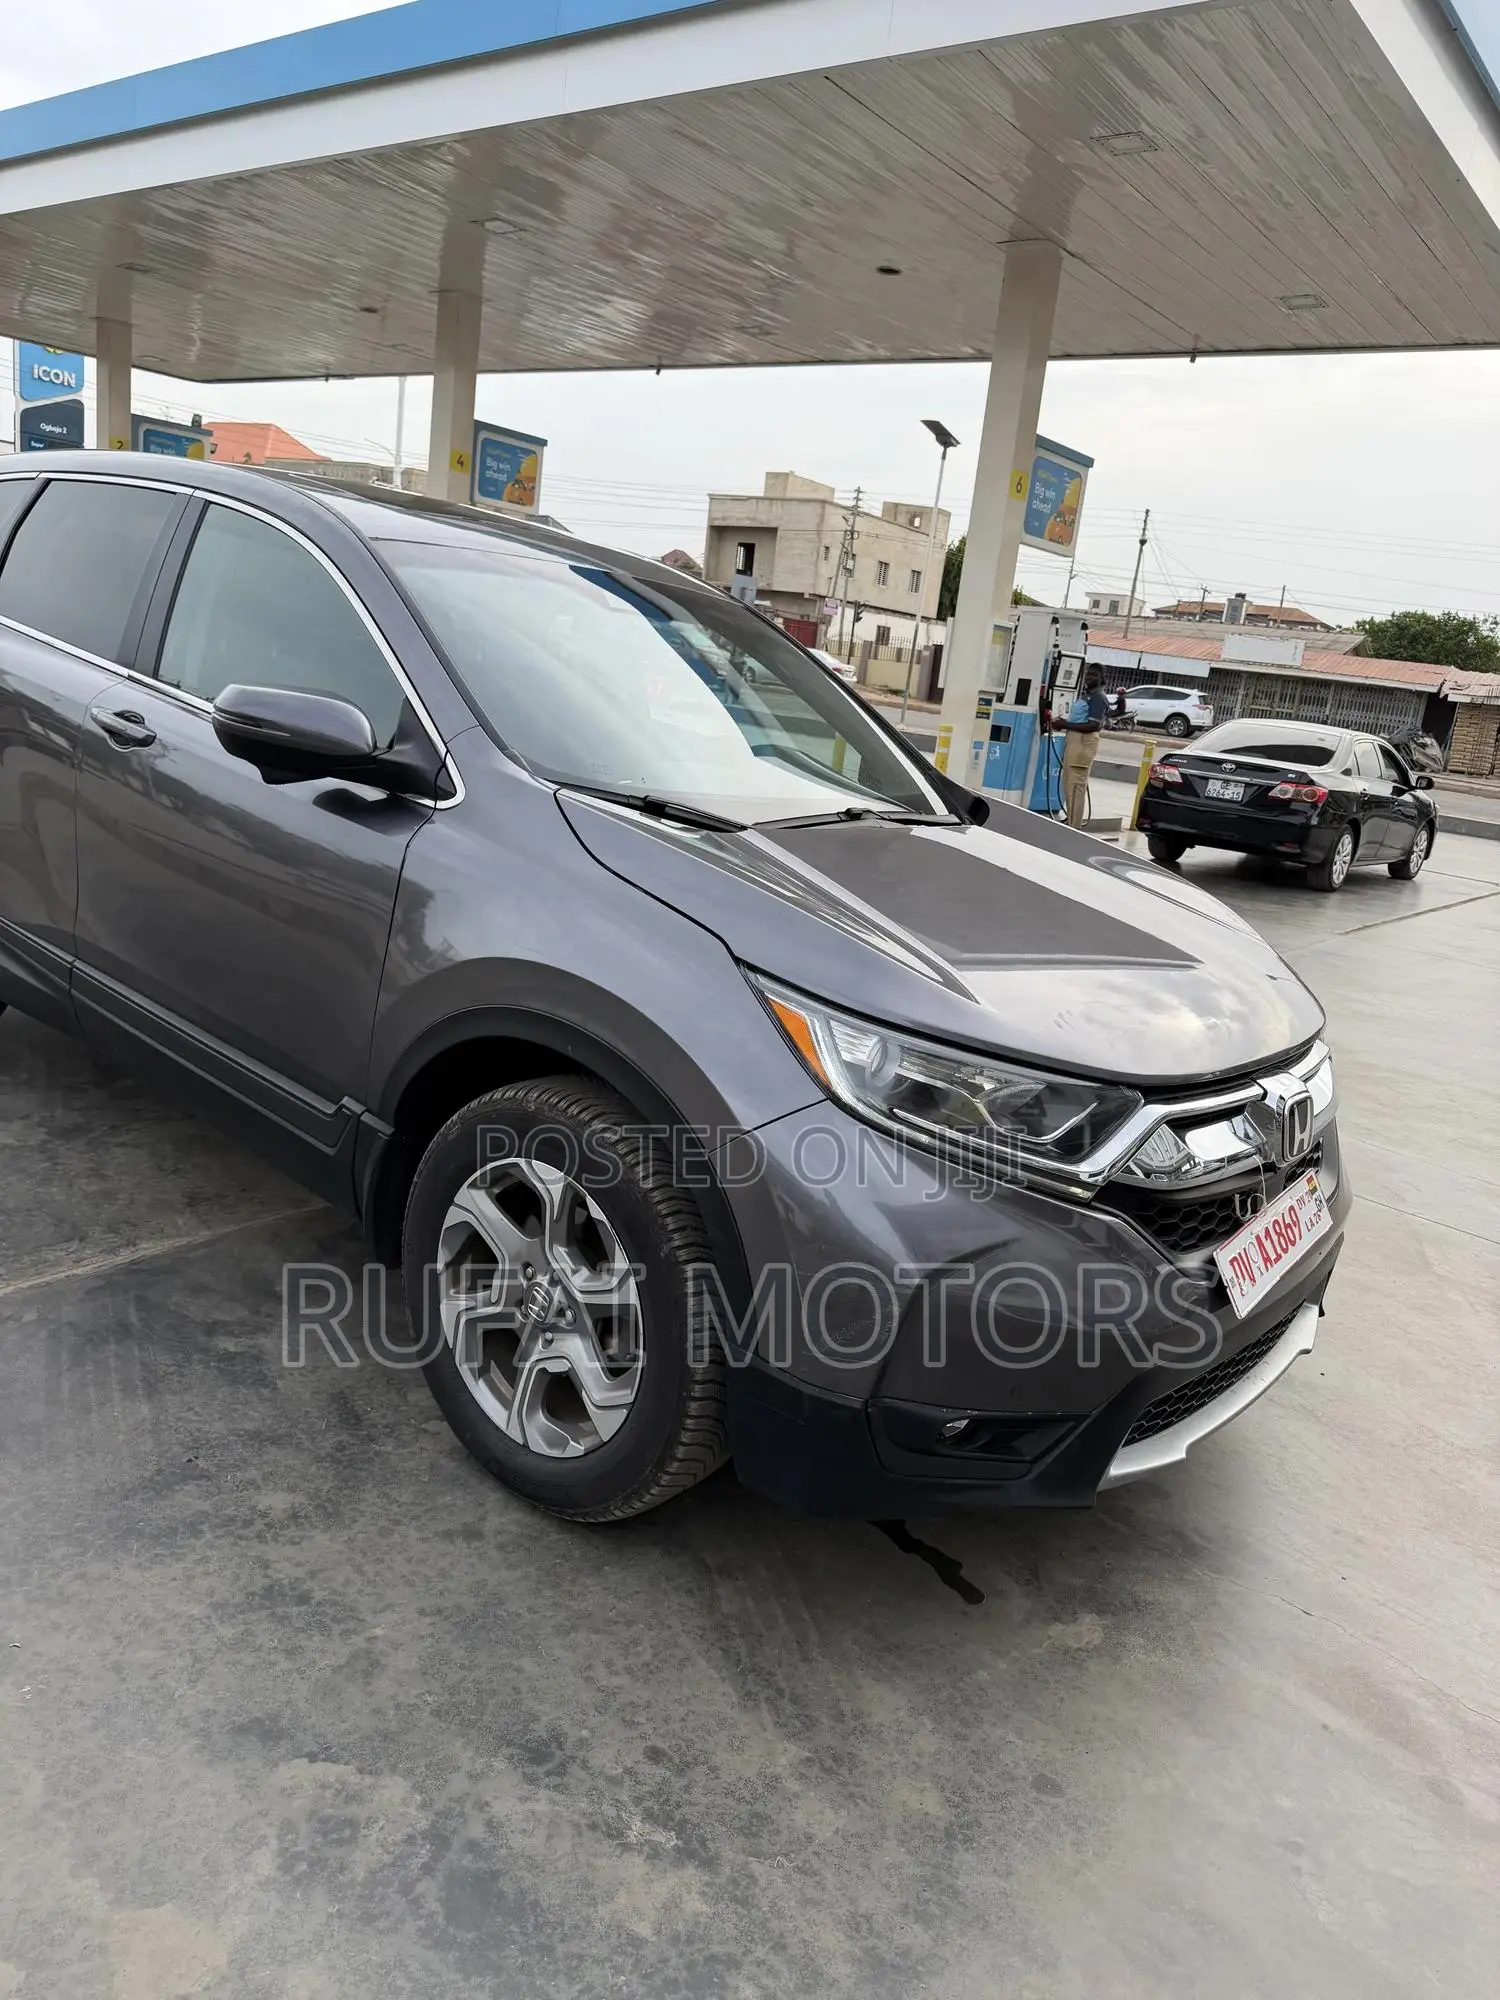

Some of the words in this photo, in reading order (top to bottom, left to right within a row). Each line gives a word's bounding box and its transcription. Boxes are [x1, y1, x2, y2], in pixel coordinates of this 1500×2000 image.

[116, 440, 124, 449] 2
[456, 454, 464, 468] 4
[486, 457, 498, 470] Big
[498, 462, 511, 472] win
[484, 469, 508, 482] ahead
[1016, 476, 1023, 494] 6
[1034, 481, 1045, 498] Big
[1045, 487, 1056, 500] win
[1031, 497, 1052, 514] ahead
[1255, 1205, 1302, 1272] A1869
